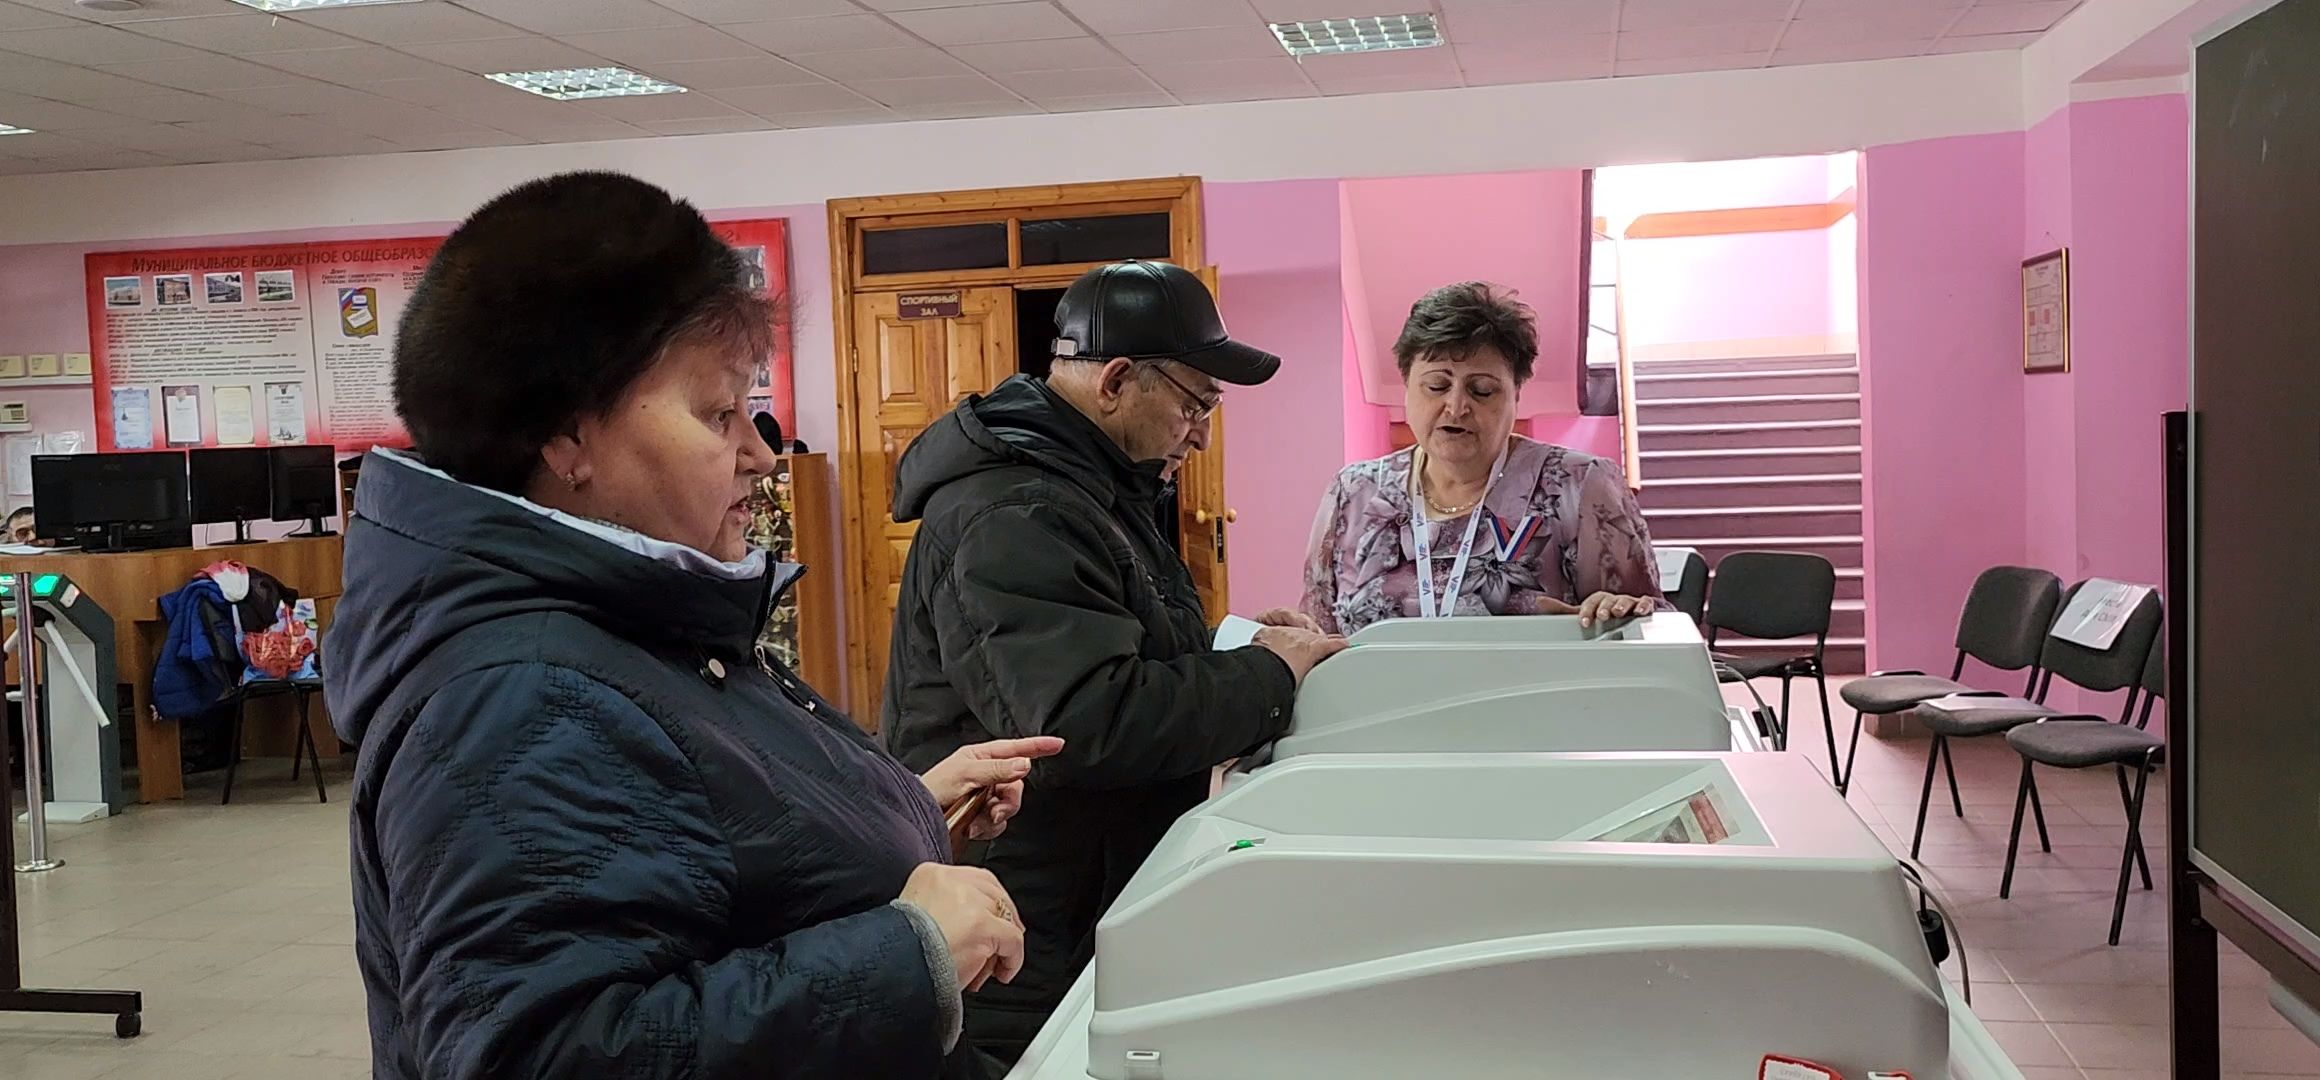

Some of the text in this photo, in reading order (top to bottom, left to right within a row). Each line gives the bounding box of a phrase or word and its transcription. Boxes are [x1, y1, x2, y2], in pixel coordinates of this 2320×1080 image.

[252, 253, 338, 268] БЮДЖЕТНОЕ
[342, 247, 434, 263] ОБЩЕОБРАЗО
[900, 294, 958, 305] СПОРТИВНЫЙ
[920, 307, 939, 316] ЗАЛ
